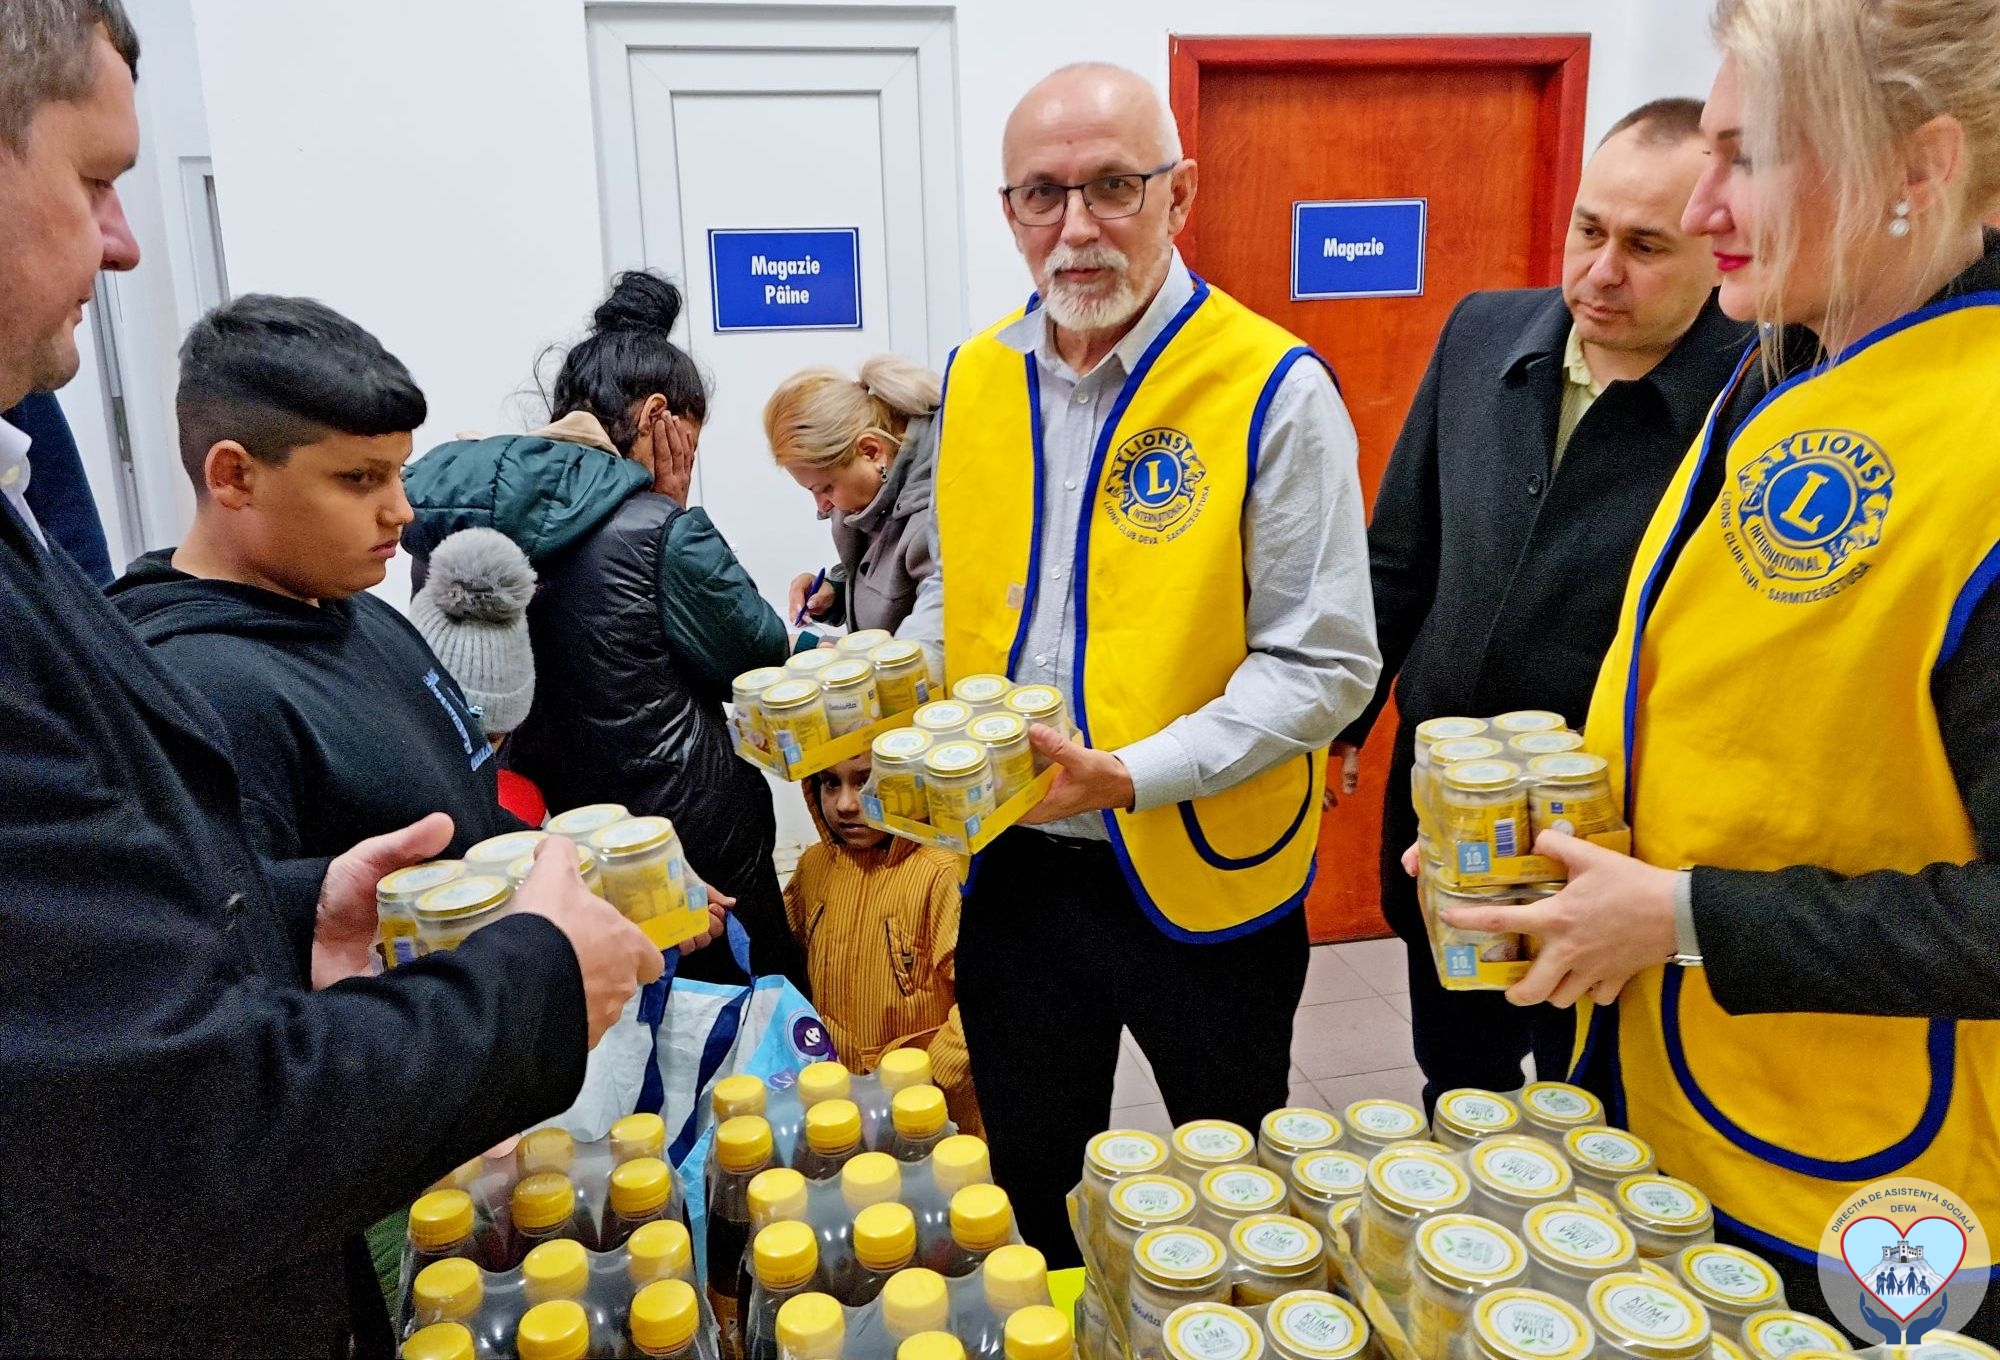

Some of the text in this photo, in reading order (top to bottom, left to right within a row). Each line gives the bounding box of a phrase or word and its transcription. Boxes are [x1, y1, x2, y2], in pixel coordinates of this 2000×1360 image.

[1323, 237, 1385, 262] Magazie
[751, 255, 821, 281] Magazie
[764, 284, 811, 305] Pâine
[1124, 431, 1184, 457] LIONS
[1801, 434, 1885, 483] LIONS
[1145, 459, 1171, 496] L
[1719, 490, 1733, 530] LIONS
[1779, 470, 1830, 535] L
[1723, 531, 1744, 564] CLUB
[1749, 523, 1823, 573] INTERNATIONAL
[1740, 563, 1760, 592] DEVA
